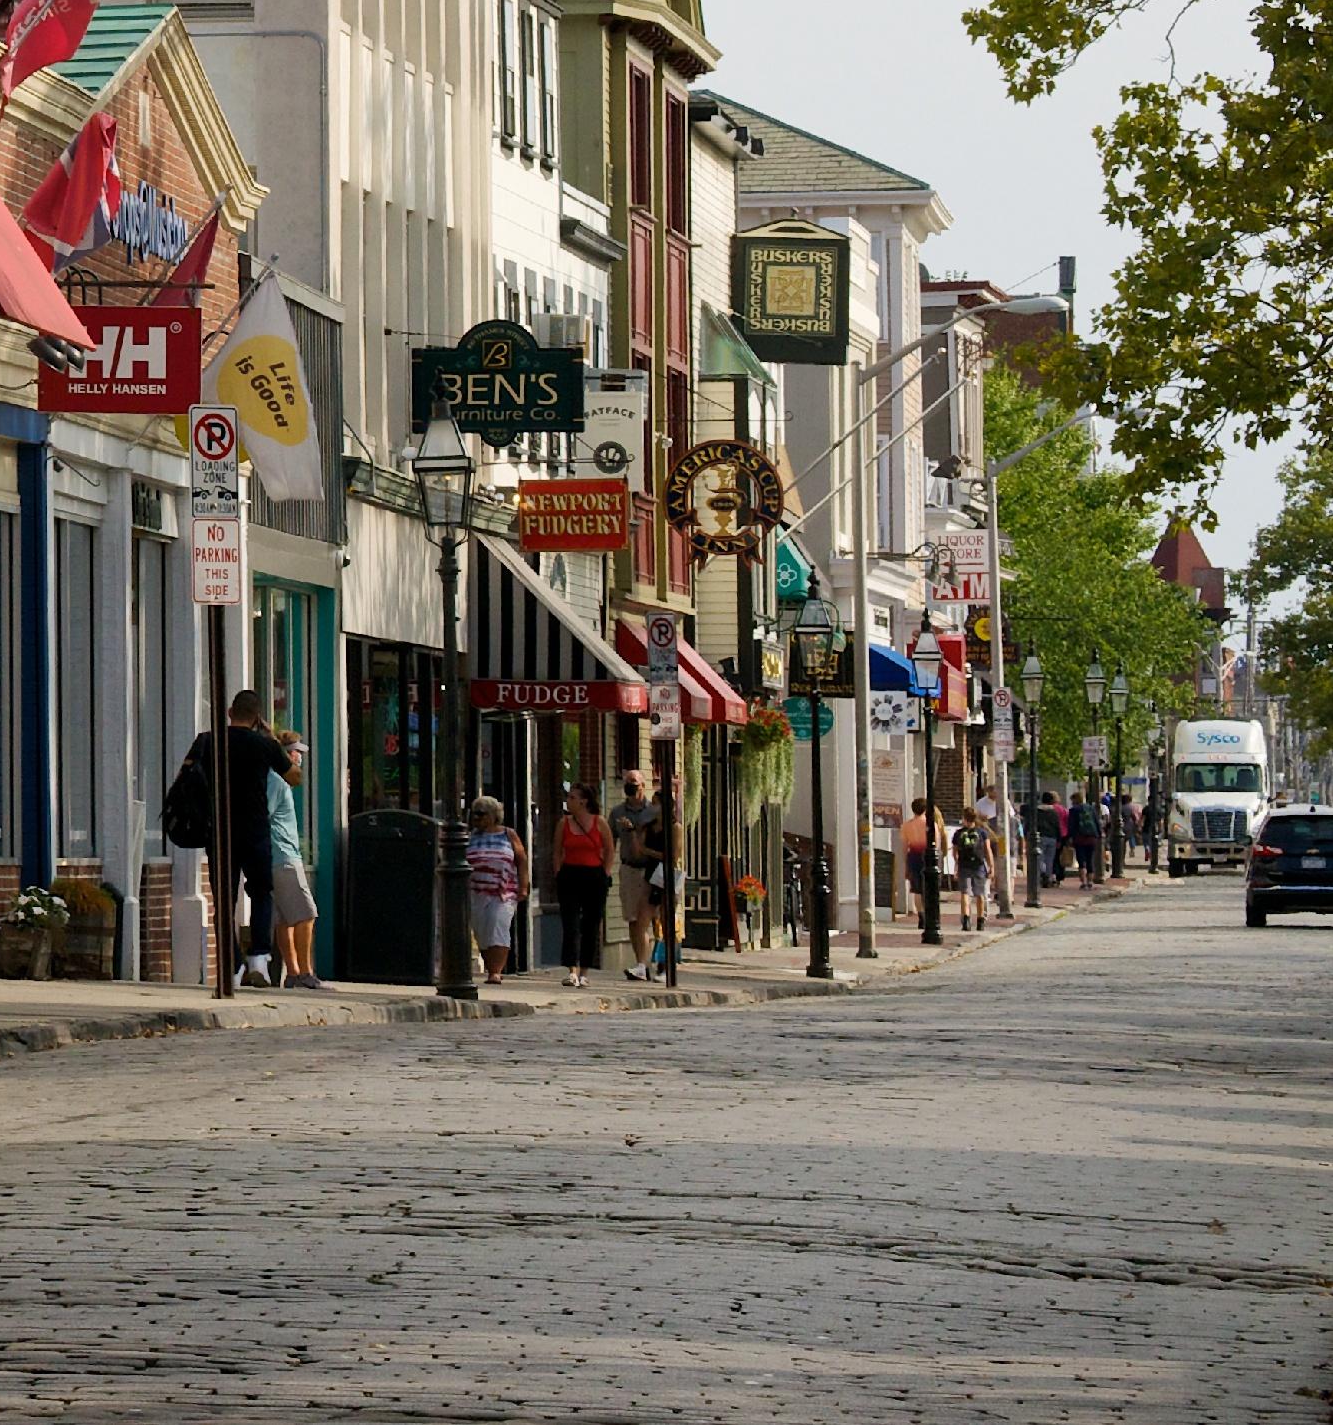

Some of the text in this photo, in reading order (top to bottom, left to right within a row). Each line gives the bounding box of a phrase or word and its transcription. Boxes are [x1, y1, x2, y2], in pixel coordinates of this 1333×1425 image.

[750, 249, 833, 264] BUSKERS
[235, 355, 255, 375] is
[68, 383, 167, 395] HELLY HANSEN
[268, 362, 295, 406] Life
[439, 372, 558, 406] BEN'S
[454, 407, 562, 422] urniture Co.
[585, 406, 636, 420] FATFACE
[195, 460, 236, 472] LOADING
[203, 472, 227, 483] ZONE
[523, 493, 624, 512] NEWPORT
[523, 514, 623, 536] FUDGERY
[207, 526, 225, 542] NO
[937, 535, 985, 546] LIQUOR
[195, 547, 238, 563] PARKING
[940, 548, 983, 559] STORE
[204, 568, 229, 579] THIS
[204, 584, 229, 596] SIDE
[935, 573, 991, 600] ATM
[496, 683, 590, 704] FUDGE
[1196, 732, 1241, 746] Sysco
